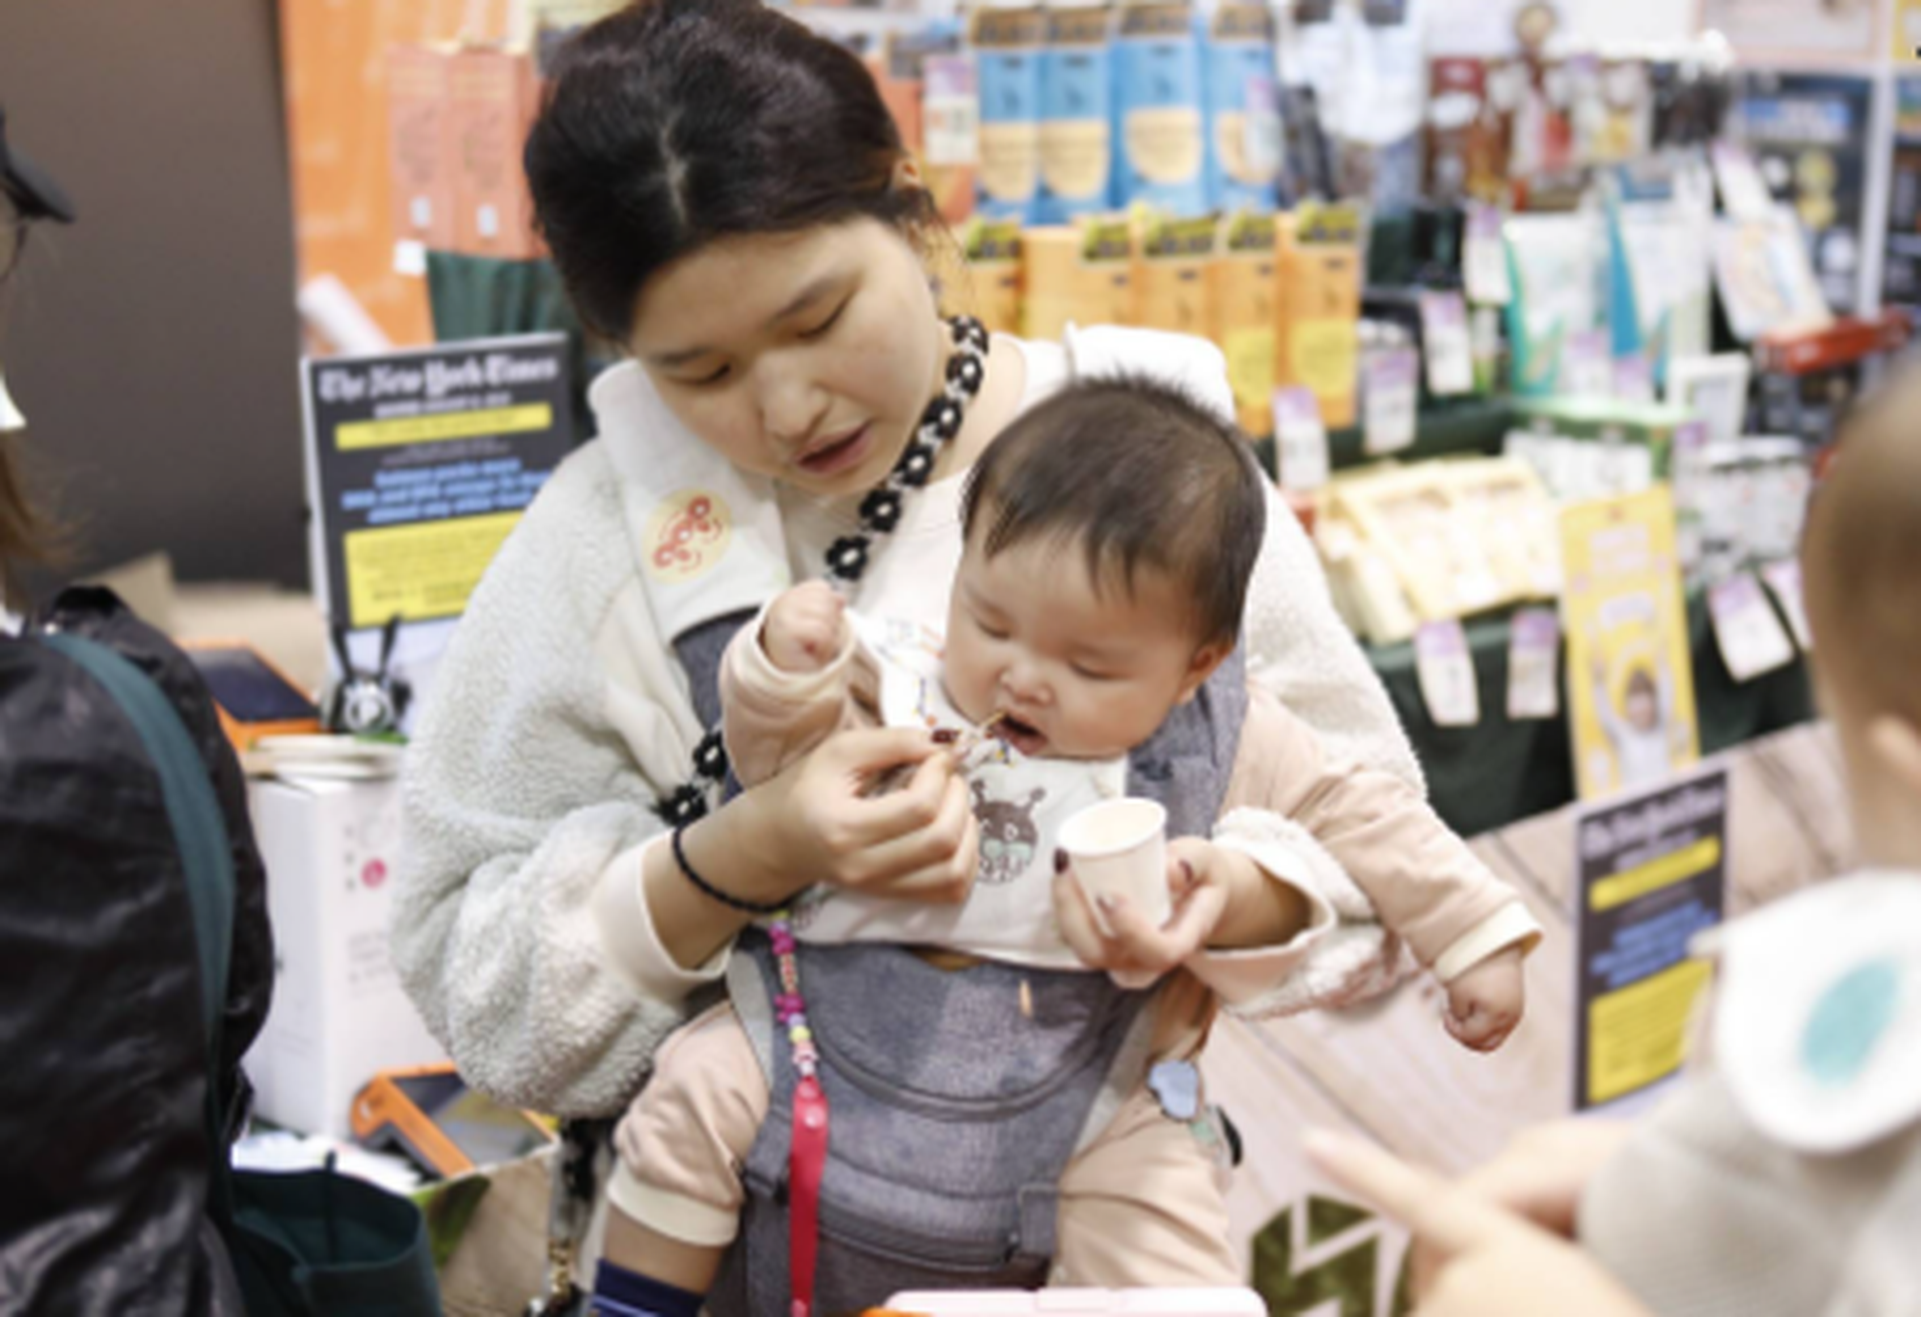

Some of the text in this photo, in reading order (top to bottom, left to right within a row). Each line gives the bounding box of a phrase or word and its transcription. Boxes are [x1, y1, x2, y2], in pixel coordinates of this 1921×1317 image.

[318, 353, 558, 403] The New York Times
